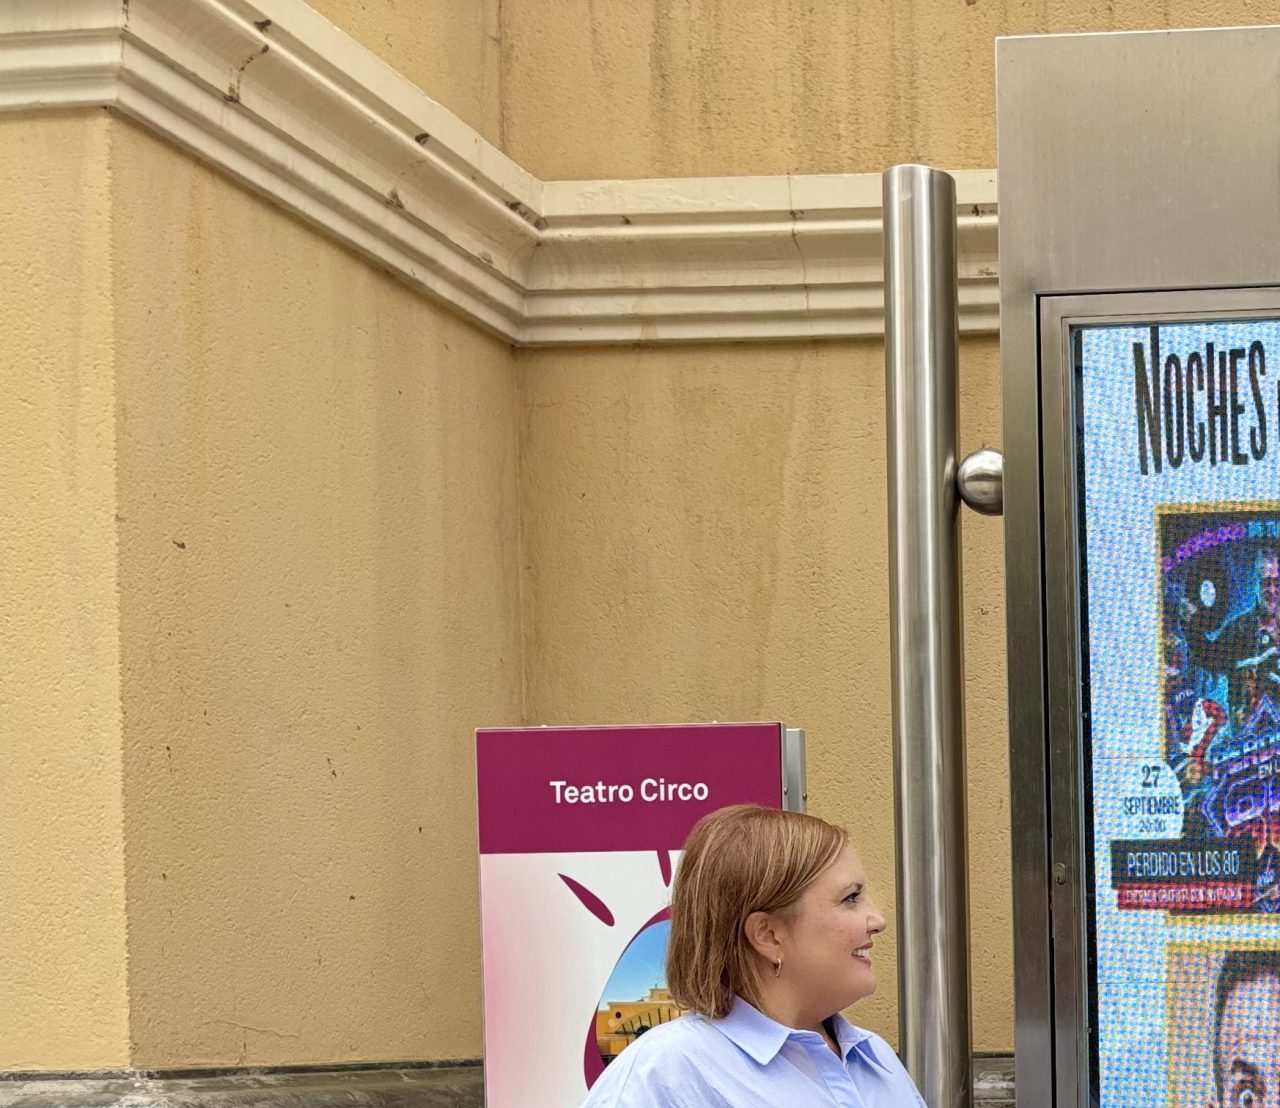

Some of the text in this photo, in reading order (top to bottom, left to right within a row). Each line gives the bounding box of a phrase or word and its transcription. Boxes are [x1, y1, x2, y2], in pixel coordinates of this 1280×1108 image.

[1133, 326, 1267, 475] NOCHES
[1141, 765, 1161, 788] 27
[549, 778, 709, 804] Teatro Circo
[1124, 796, 1180, 815] SEPTIEMBRE
[1127, 851, 1177, 877] PERDIDO
[1180, 851, 1194, 876] EN
[1198, 851, 1221, 876] LOS
